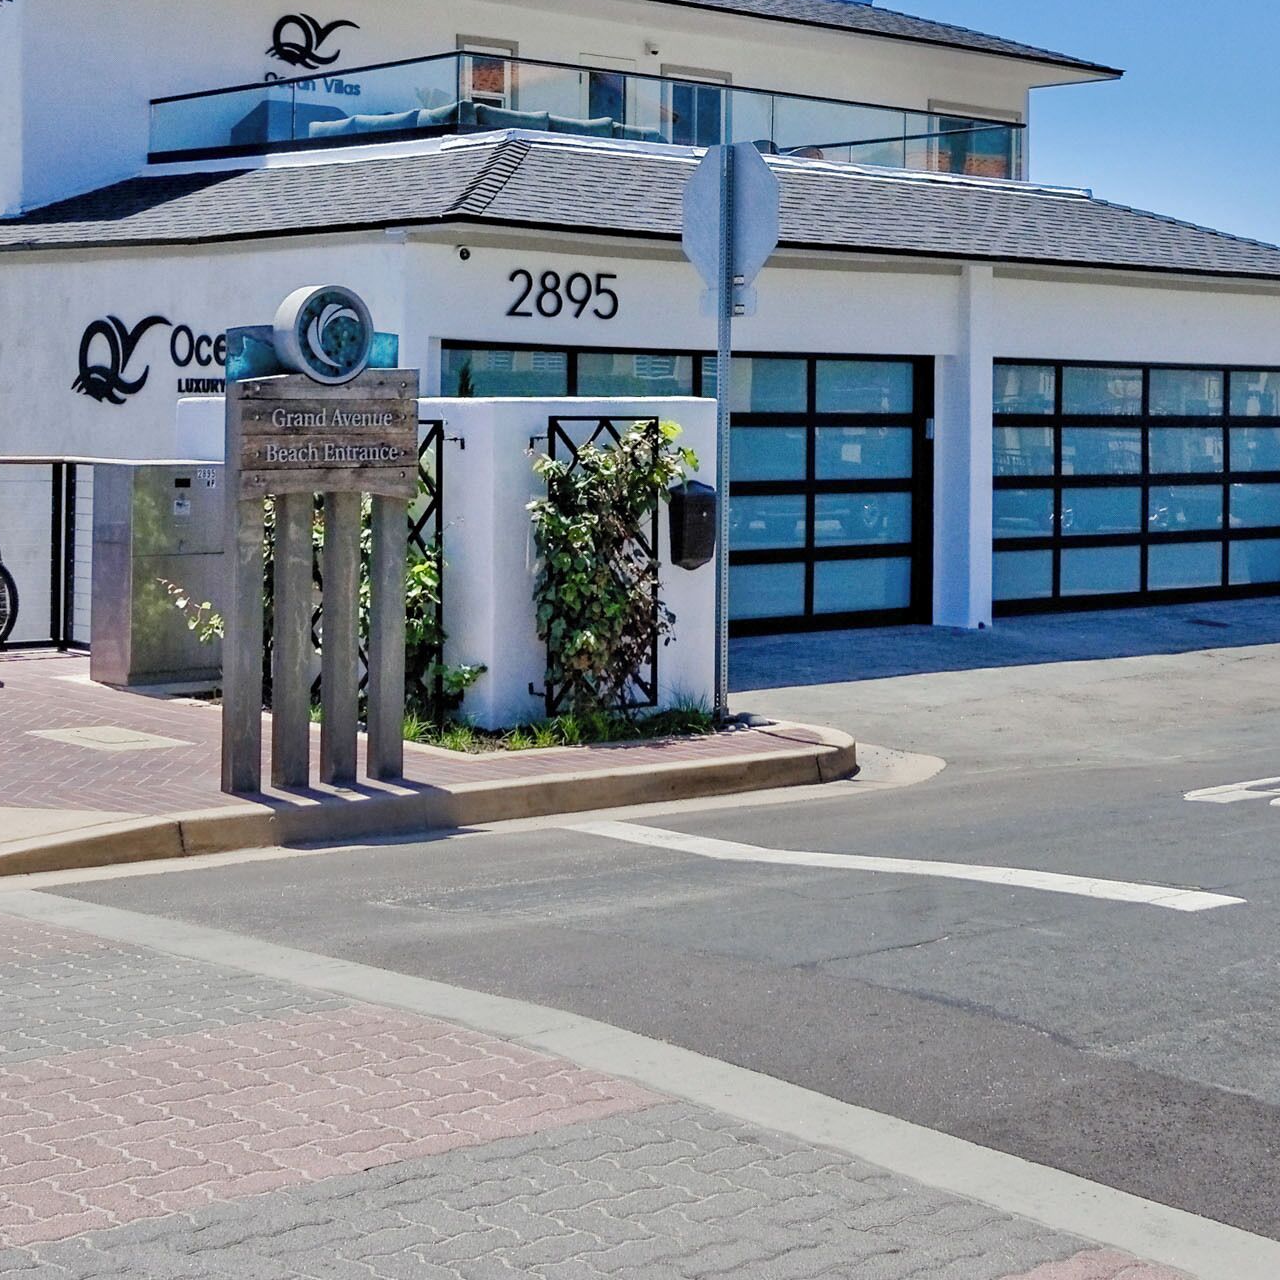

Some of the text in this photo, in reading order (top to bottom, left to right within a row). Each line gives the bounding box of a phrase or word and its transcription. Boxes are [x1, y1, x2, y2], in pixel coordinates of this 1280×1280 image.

[324, 77, 361, 96] Villas
[506, 269, 619, 320] 2895
[177, 378, 226, 394] LUXURY
[272, 408, 393, 428] Grand Avenue
[266, 443, 399, 463] Beach Entrance
